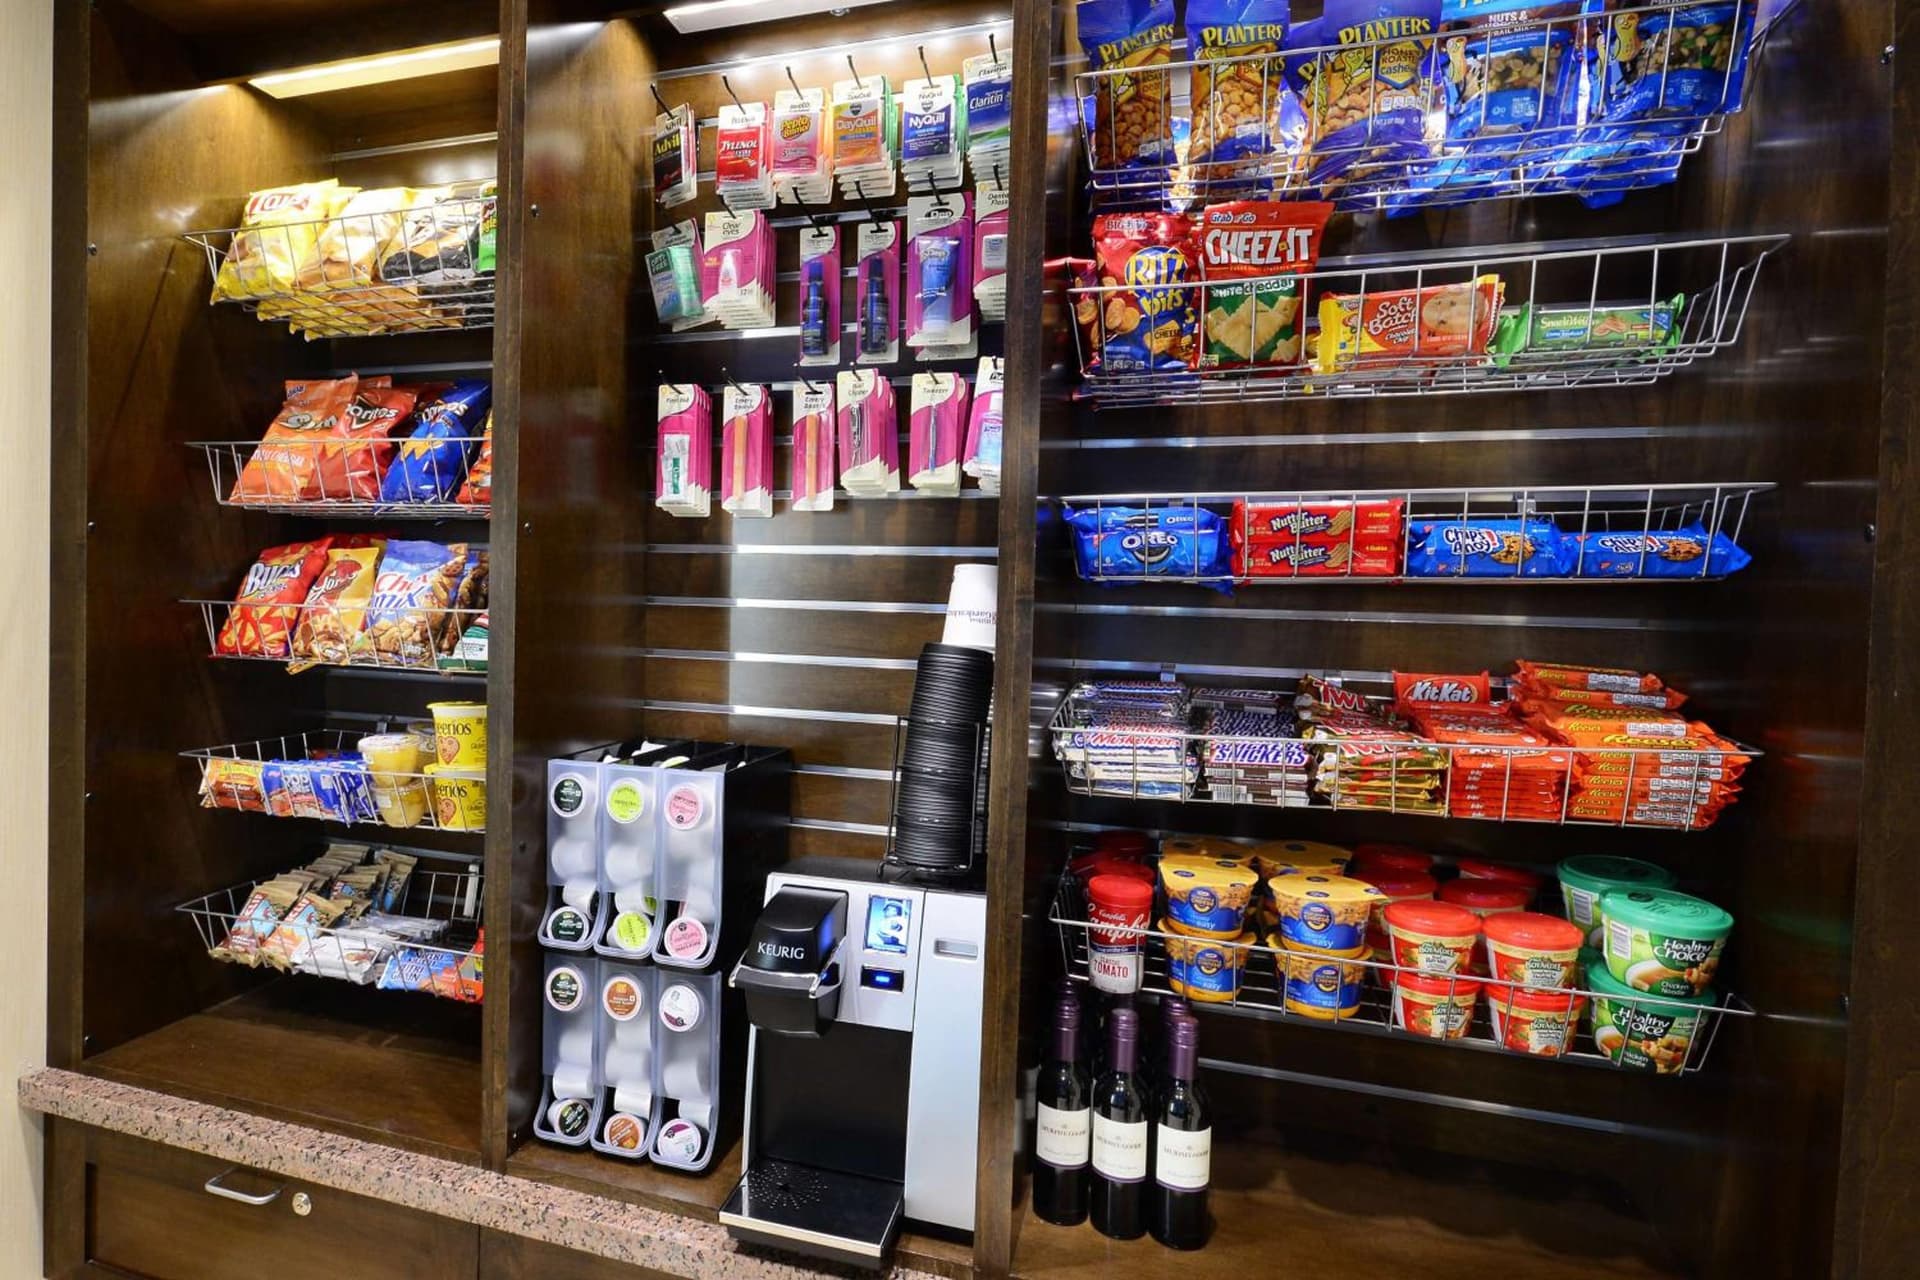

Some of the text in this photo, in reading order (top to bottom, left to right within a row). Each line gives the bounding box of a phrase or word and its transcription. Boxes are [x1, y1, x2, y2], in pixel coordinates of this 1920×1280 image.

[1488, 10, 1529, 23] NUTS &
[1201, 24, 1283, 47] PLANTERS
[1338, 18, 1431, 44] PLANTERS
[969, 94, 1004, 109] Claritin
[836, 116, 877, 131] DayQuil
[908, 112, 946, 128] NyQuil
[655, 131, 682, 155] Advil
[719, 140, 759, 153] TYLENOL
[1209, 214, 1233, 224] Grab
[1242, 213, 1256, 223] Go
[1128, 254, 1186, 288] RITZ
[1376, 297, 1415, 319] Soft
[1270, 511, 1308, 531] Nutter
[1291, 514, 1327, 534] Butter
[1122, 532, 1178, 549] OREO
[1269, 543, 1305, 563] Nutter
[1289, 546, 1326, 566] Butter
[1568, 720, 1601, 732] Reese's
[1215, 748, 1308, 766] SNICKERS
[757, 940, 806, 961] KEURIG
[1653, 945, 1707, 962] Choice
[1663, 939, 1713, 955] Healthy
[1093, 960, 1129, 978] TOMATO
[1618, 1007, 1670, 1027] Halthy
